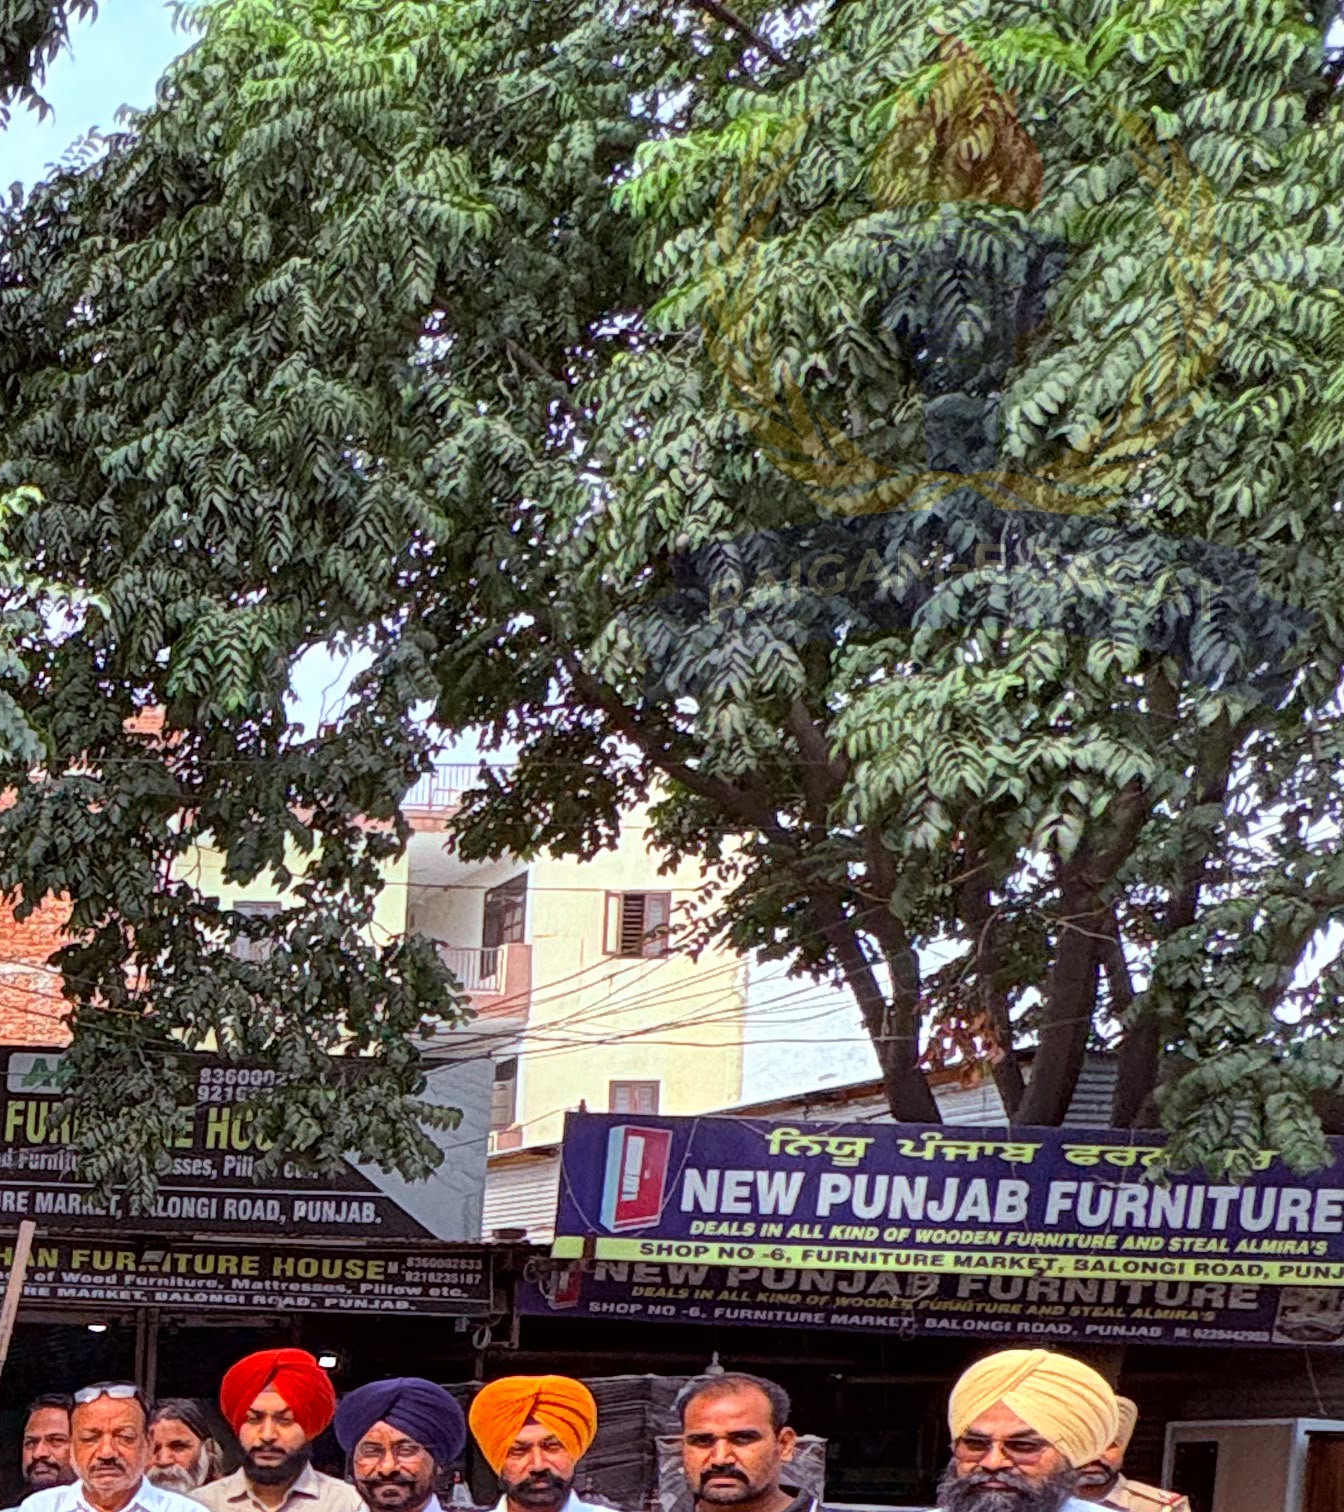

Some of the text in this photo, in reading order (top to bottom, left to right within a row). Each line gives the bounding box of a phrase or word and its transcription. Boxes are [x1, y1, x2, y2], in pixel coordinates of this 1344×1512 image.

[895, 1132, 1043, 1168] ਪੰਜਾਬ
[223, 1198, 287, 1225] ROAD,
[293, 1200, 382, 1226] PUNJAB.
[680, 1167, 1344, 1233] NEW PUNJAB FURNITURE
[689, 1219, 1329, 1257] DEALS IN ALL KIND OF WOODEN FURNITURE AND STEAL ALMIRA'S
[272, 1256, 386, 1281] HOUSE
[639, 1243, 710, 1259] SHOP
[717, 1246, 755, 1260] NO
[801, 1249, 944, 1267] FURNITURE
[953, 1255, 1064, 1274] MARKET,
[1073, 1259, 1185, 1276] BALONGI
[1193, 1262, 1269, 1280] ROAD,
[33, 1271, 56, 1284] of
[61, 1272, 118, 1287] Wood
[124, 1274, 226, 1291] Furniture,
[231, 1277, 353, 1296] Mattresses,
[359, 1282, 423, 1297] Pillow
[428, 1285, 469, 1299] etc.
[56, 1286, 148, 1302] MARKET,
[153, 1289, 245, 1305] BALONGI
[251, 1294, 318, 1309] ROAD,
[323, 1297, 417, 1311] PUNJAB.
[593, 1262, 1260, 1311] NEW PUNJAB FURNITURE
[630, 1285, 689, 1300] DEALS
[692, 1287, 715, 1301] IN
[715, 1288, 752, 1303] ALL
[755, 1290, 802, 1305] KIND
[805, 1293, 831, 1306] OF
[916, 1298, 1023, 1315] FURNITURE
[1025, 1304, 1067, 1317] AND
[1069, 1305, 1125, 1319] STEAL
[588, 1300, 643, 1315] SHOP
[646, 1303, 676, 1316] NO
[713, 1307, 826, 1325] FURNITURE
[924, 1317, 1012, 1333] BALONGI
[1016, 1321, 1080, 1336] ROAD,
[1084, 1323, 1162, 1338] PUNJAB
